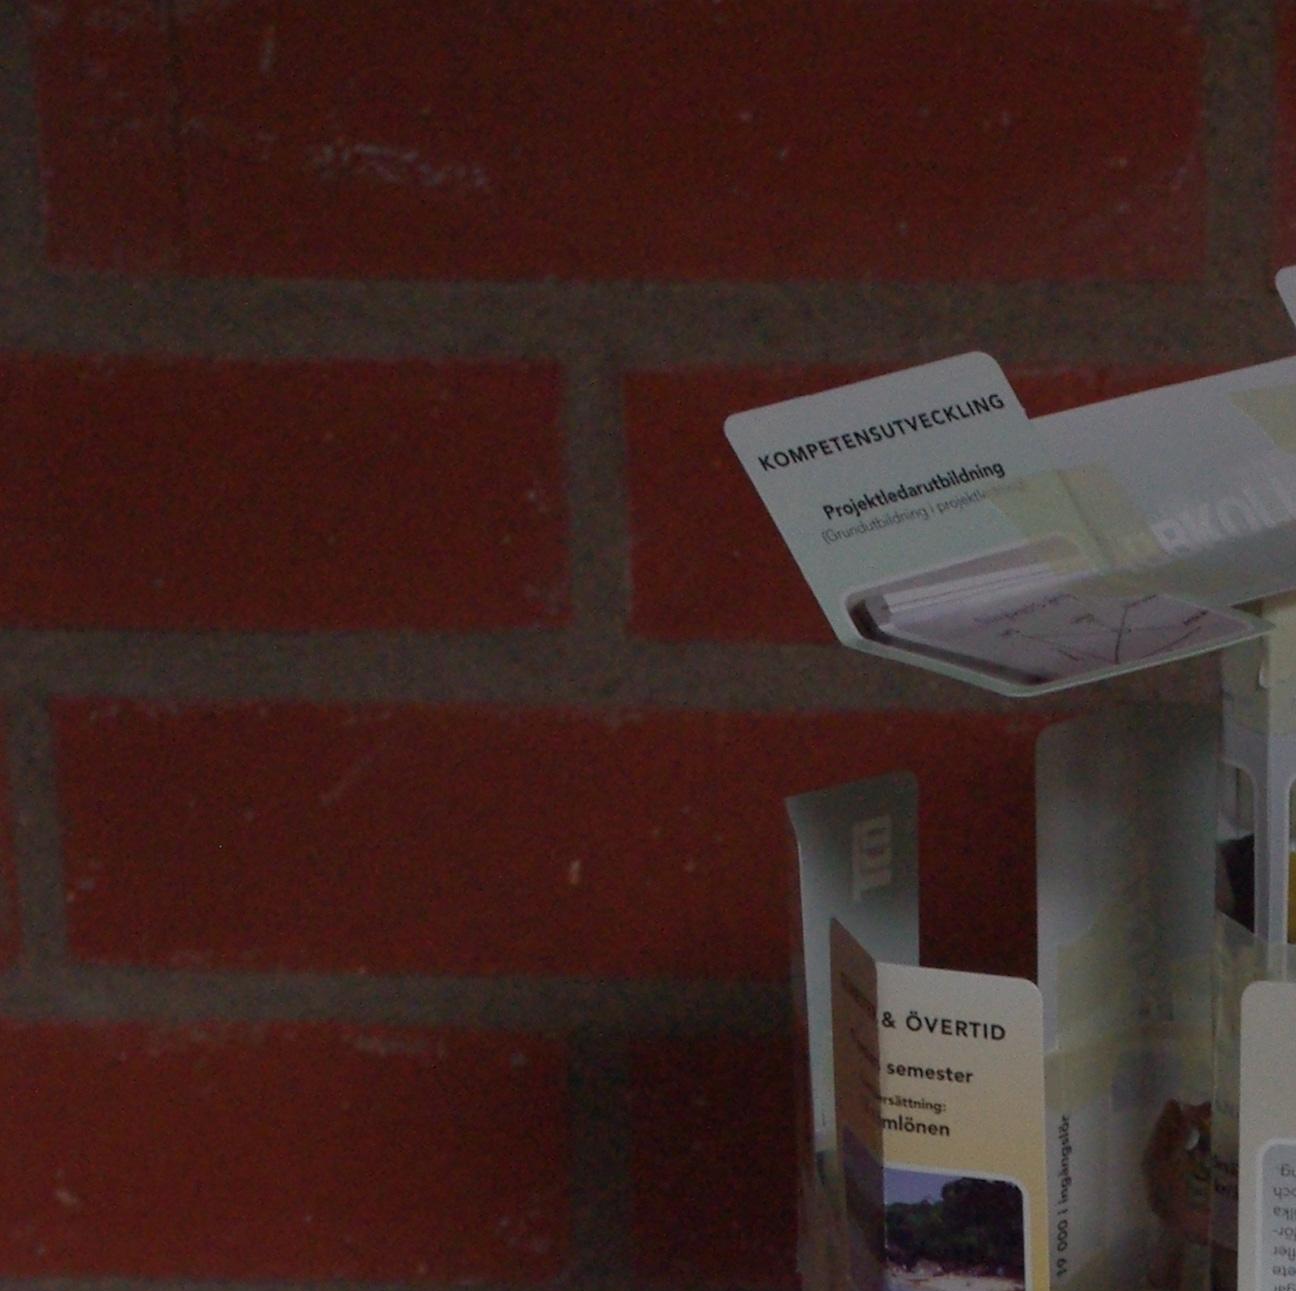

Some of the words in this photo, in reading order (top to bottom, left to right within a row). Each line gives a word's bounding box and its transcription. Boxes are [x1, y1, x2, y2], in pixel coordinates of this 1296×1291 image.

[758, 392, 1006, 474] KOMPETENSUTVECKLING
[821, 457, 1006, 521] Projektledarutbildning
[882, 1011, 896, 1029] &
[905, 1011, 1007, 1041] ÖVERTID
[886, 1062, 974, 1085] semester
[881, 1117, 951, 1138] mlönen
